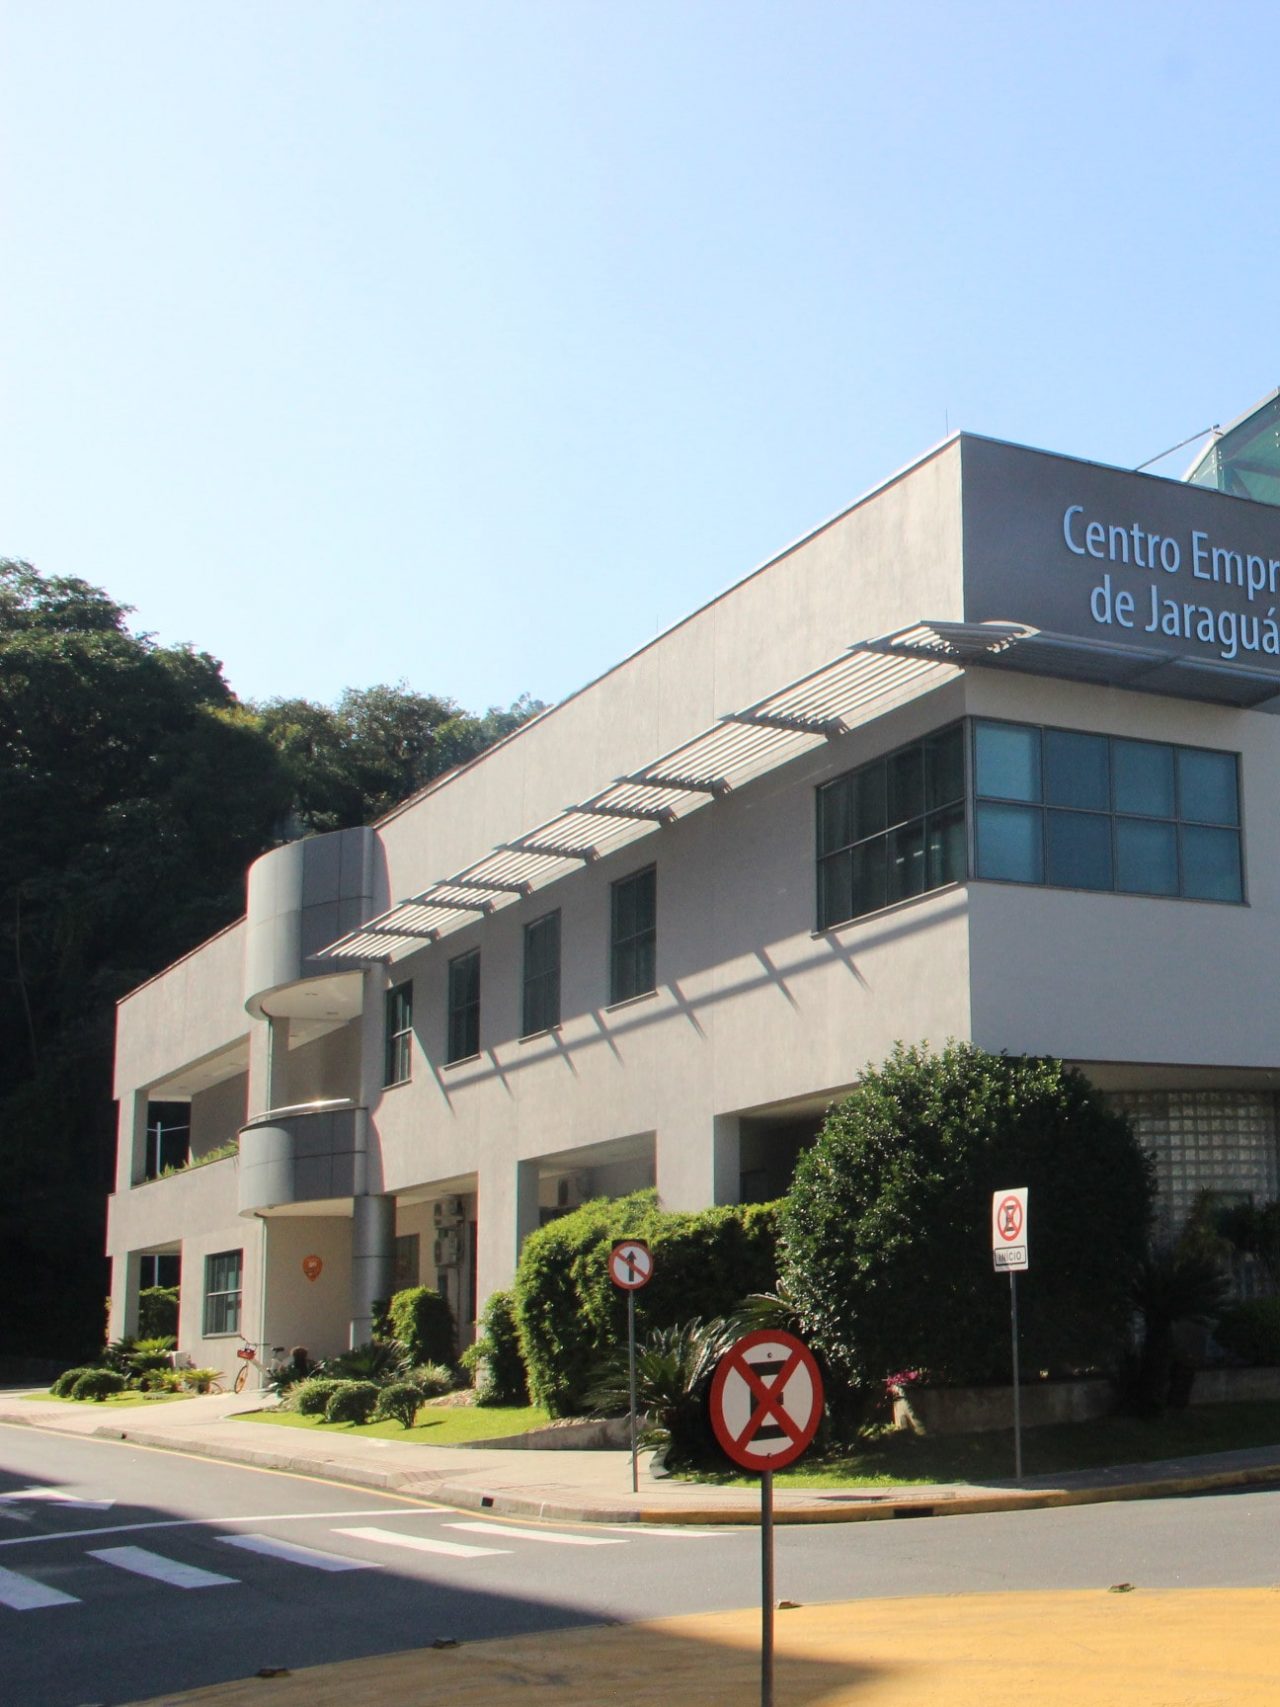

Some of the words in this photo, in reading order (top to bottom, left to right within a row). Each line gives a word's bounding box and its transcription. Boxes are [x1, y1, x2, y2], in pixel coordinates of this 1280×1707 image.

[1063, 504, 1181, 573] Centro
[1090, 574, 1135, 628] de
[1144, 584, 1280, 660] Jaraguá
